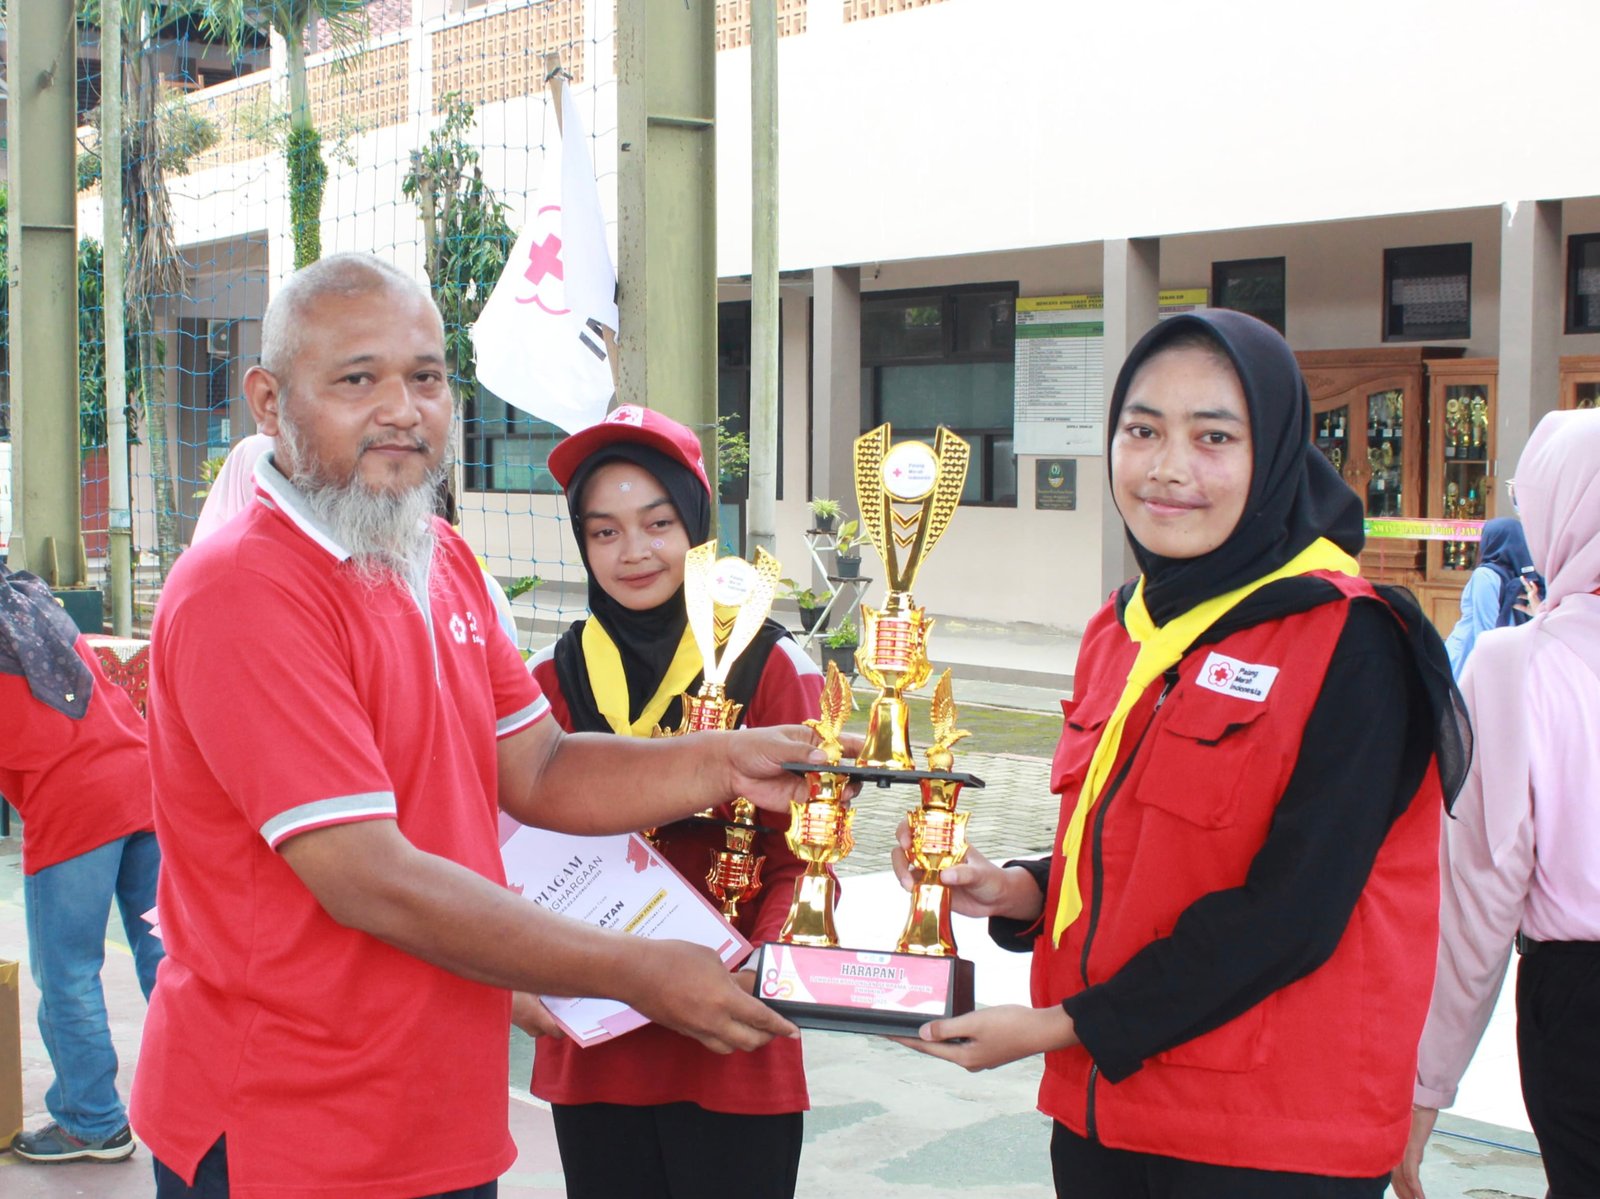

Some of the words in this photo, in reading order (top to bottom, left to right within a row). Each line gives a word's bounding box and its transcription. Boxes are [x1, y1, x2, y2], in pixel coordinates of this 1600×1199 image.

[533, 855, 584, 906] PIAGAM
[549, 856, 604, 914] GHARGAAN
[597, 900, 625, 928] ATAN
[841, 964, 896, 979] HARAPAN
